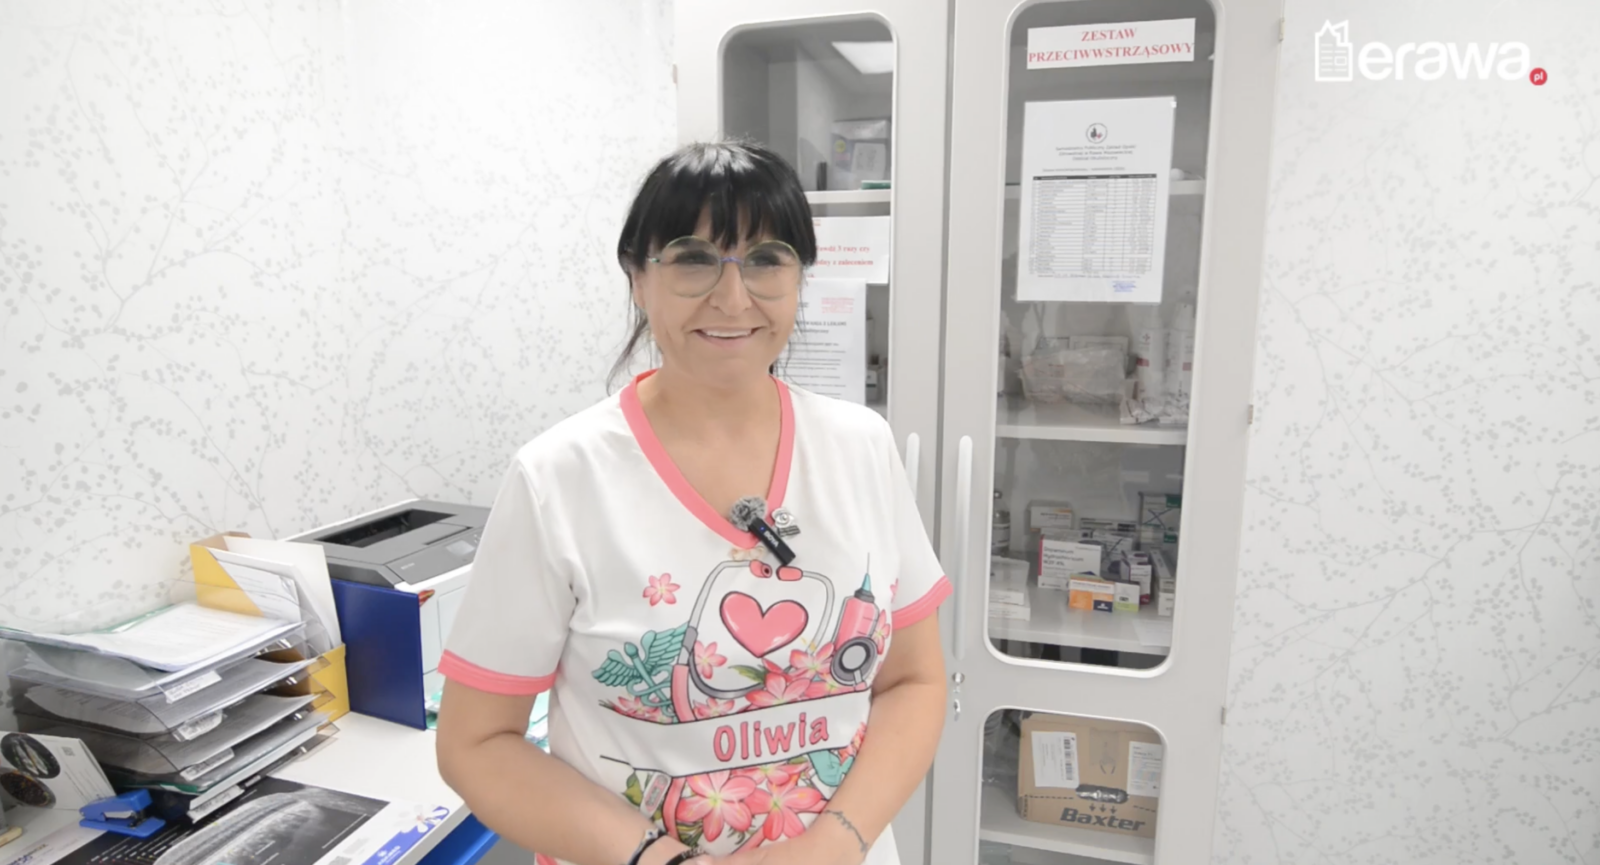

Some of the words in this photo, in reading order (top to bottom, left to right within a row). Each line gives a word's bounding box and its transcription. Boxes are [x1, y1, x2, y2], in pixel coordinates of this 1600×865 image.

[1081, 28, 1137, 42] ZESTAW
[1028, 43, 1194, 62] PRZECIWWSTRZĄSOWY
[713, 712, 829, 762] Oliwia
[1060, 807, 1145, 831] Baxter
